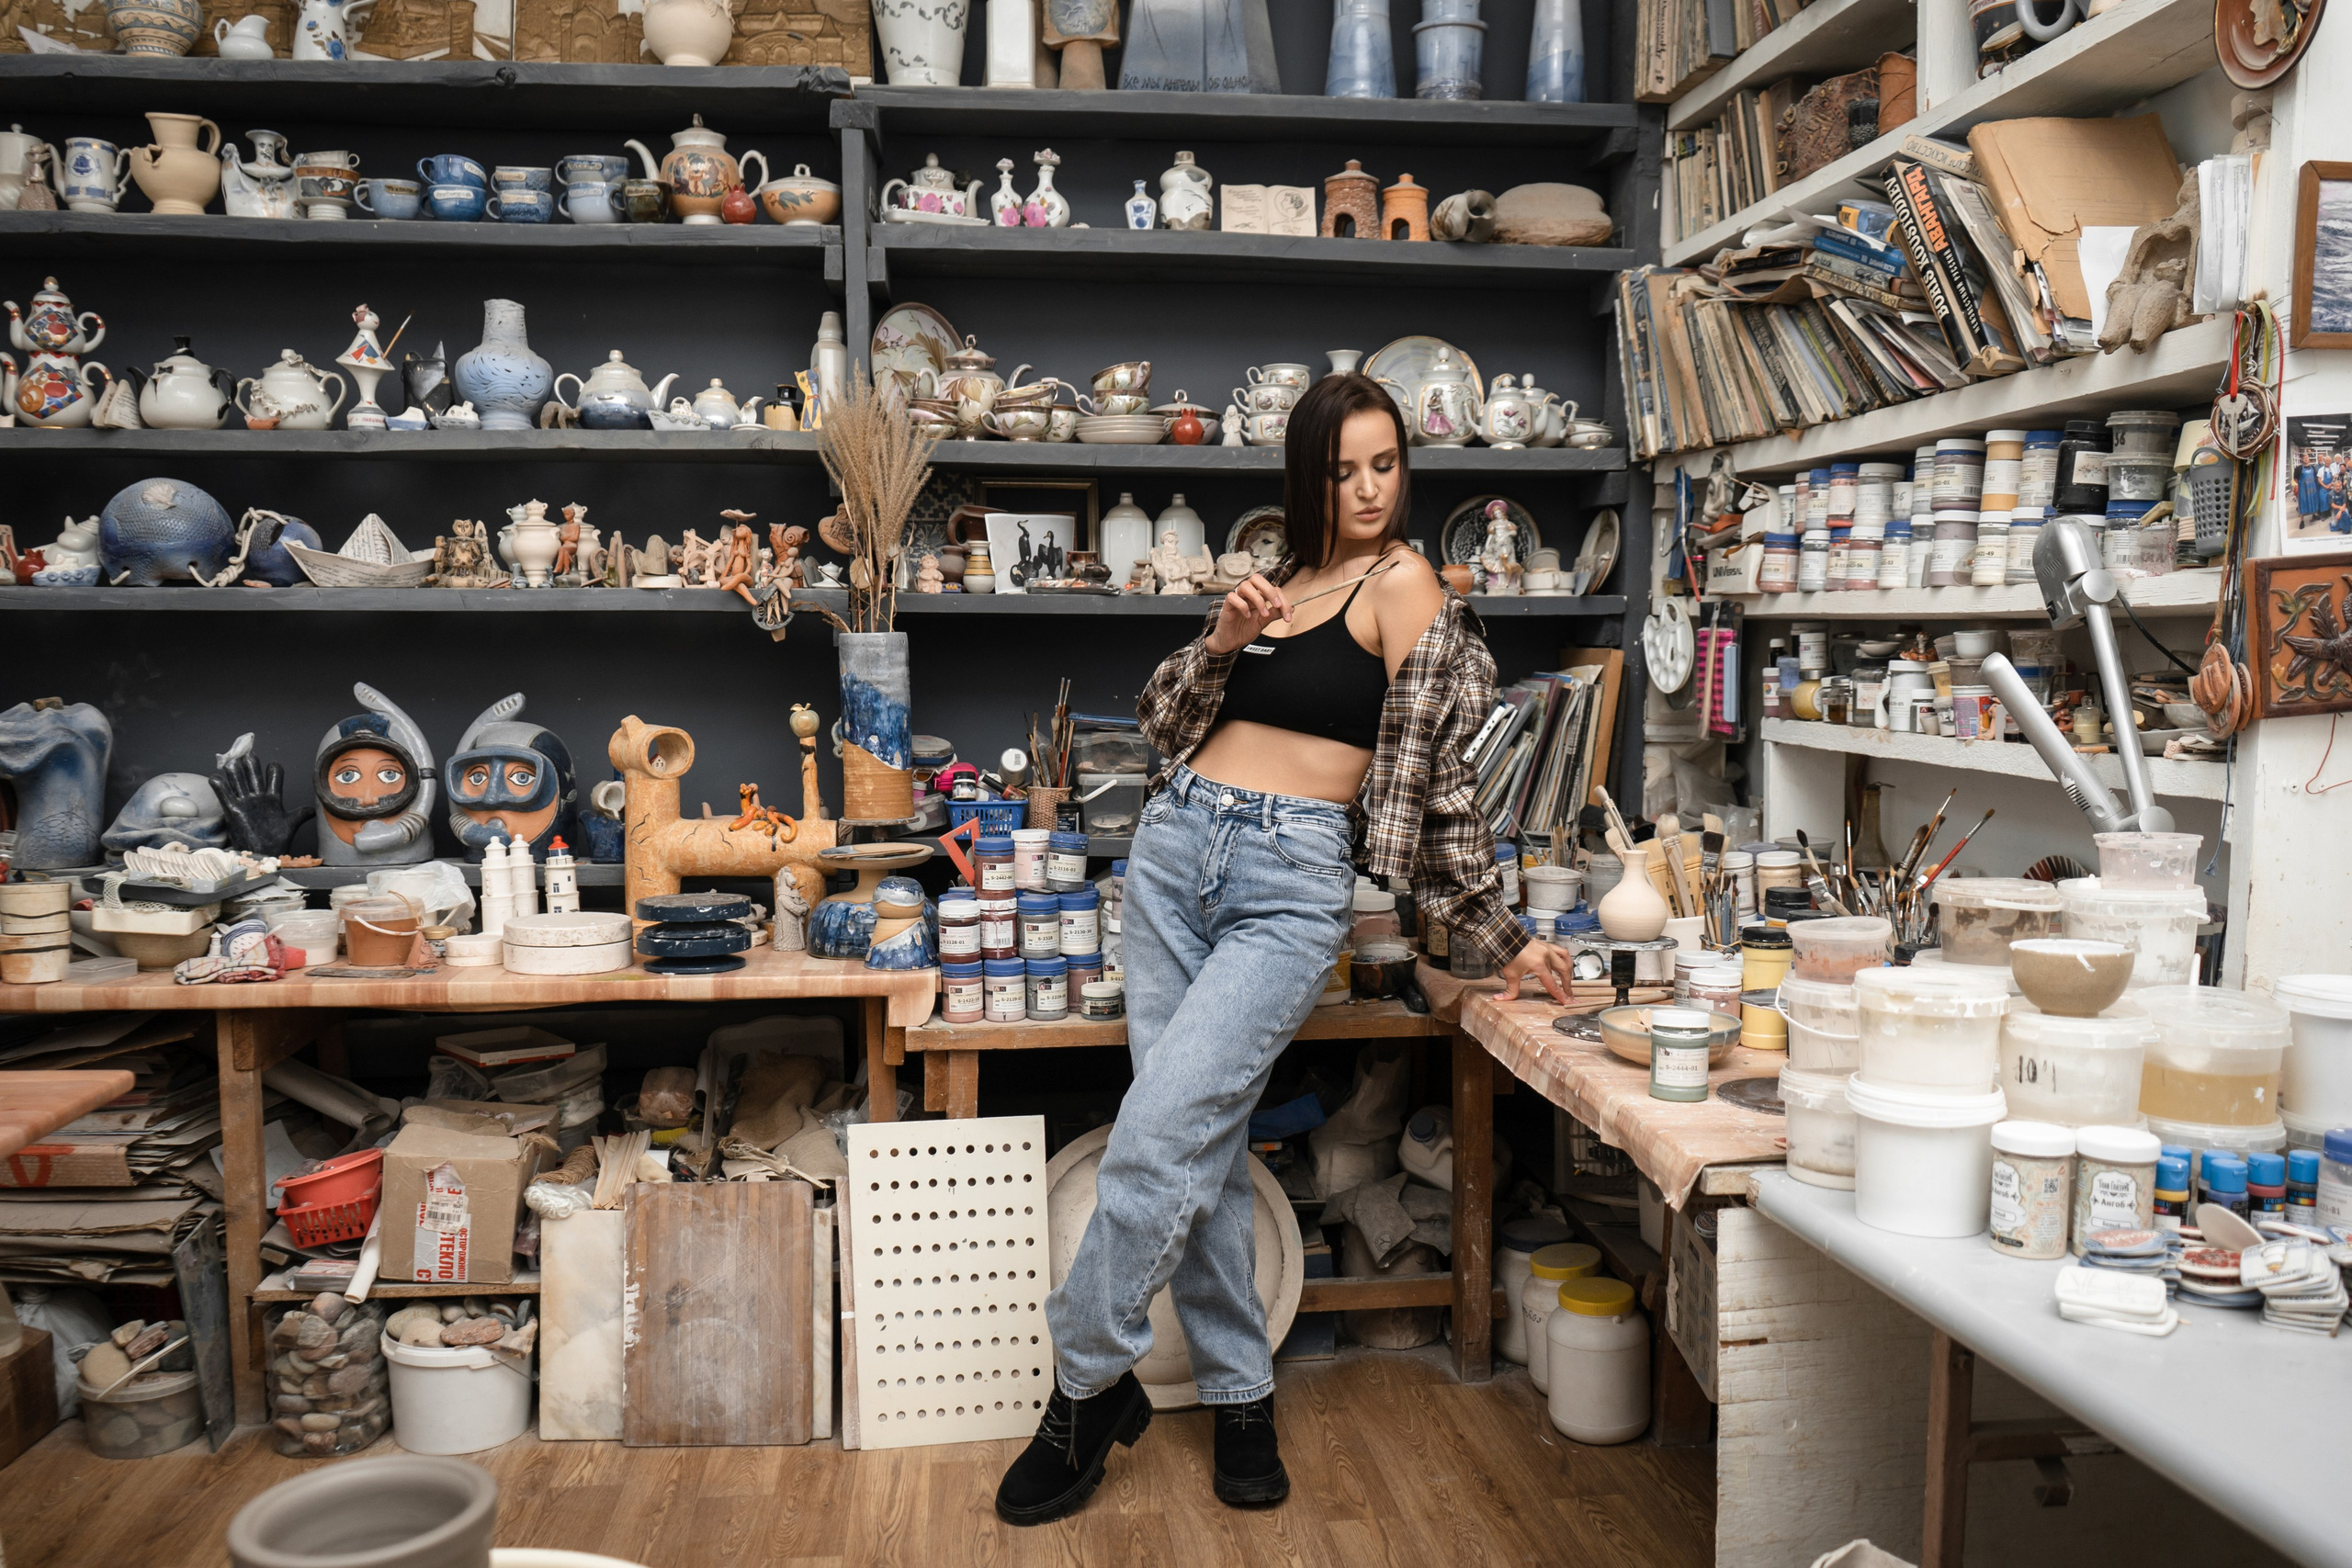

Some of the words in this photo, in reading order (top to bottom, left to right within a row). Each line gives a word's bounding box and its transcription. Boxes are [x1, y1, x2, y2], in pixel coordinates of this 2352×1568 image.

[1907, 141, 1949, 164] ИСКУССТВО
[1884, 176, 1934, 272] KOUSTODIEV
[1905, 166, 1949, 253] АВАНГАРД
[1923, 269, 1950, 321] BORIS
[1713, 566, 1743, 578] UNIVERSAL
[2101, 1198, 2125, 1208] Ангоб
[438, 1232, 456, 1280] ТЕКЛО
